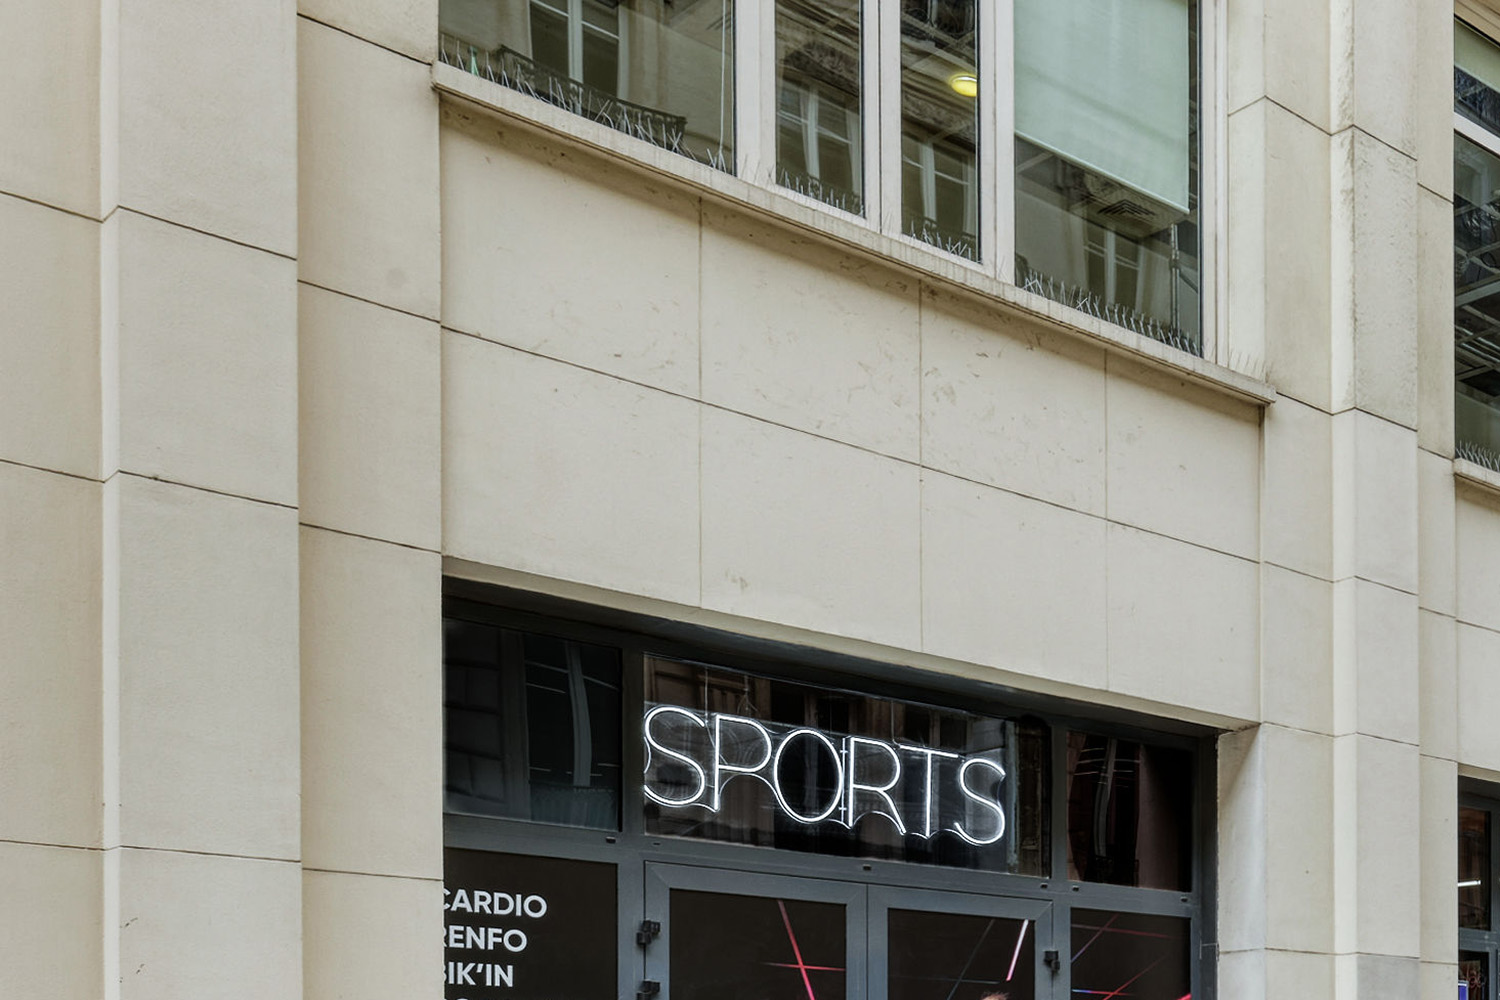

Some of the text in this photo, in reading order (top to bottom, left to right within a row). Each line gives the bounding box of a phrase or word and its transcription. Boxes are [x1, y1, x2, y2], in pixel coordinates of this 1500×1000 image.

[644, 705, 1006, 847] SPORTS
[444, 925, 528, 952] ENFO
[443, 961, 514, 987] IK'IN
